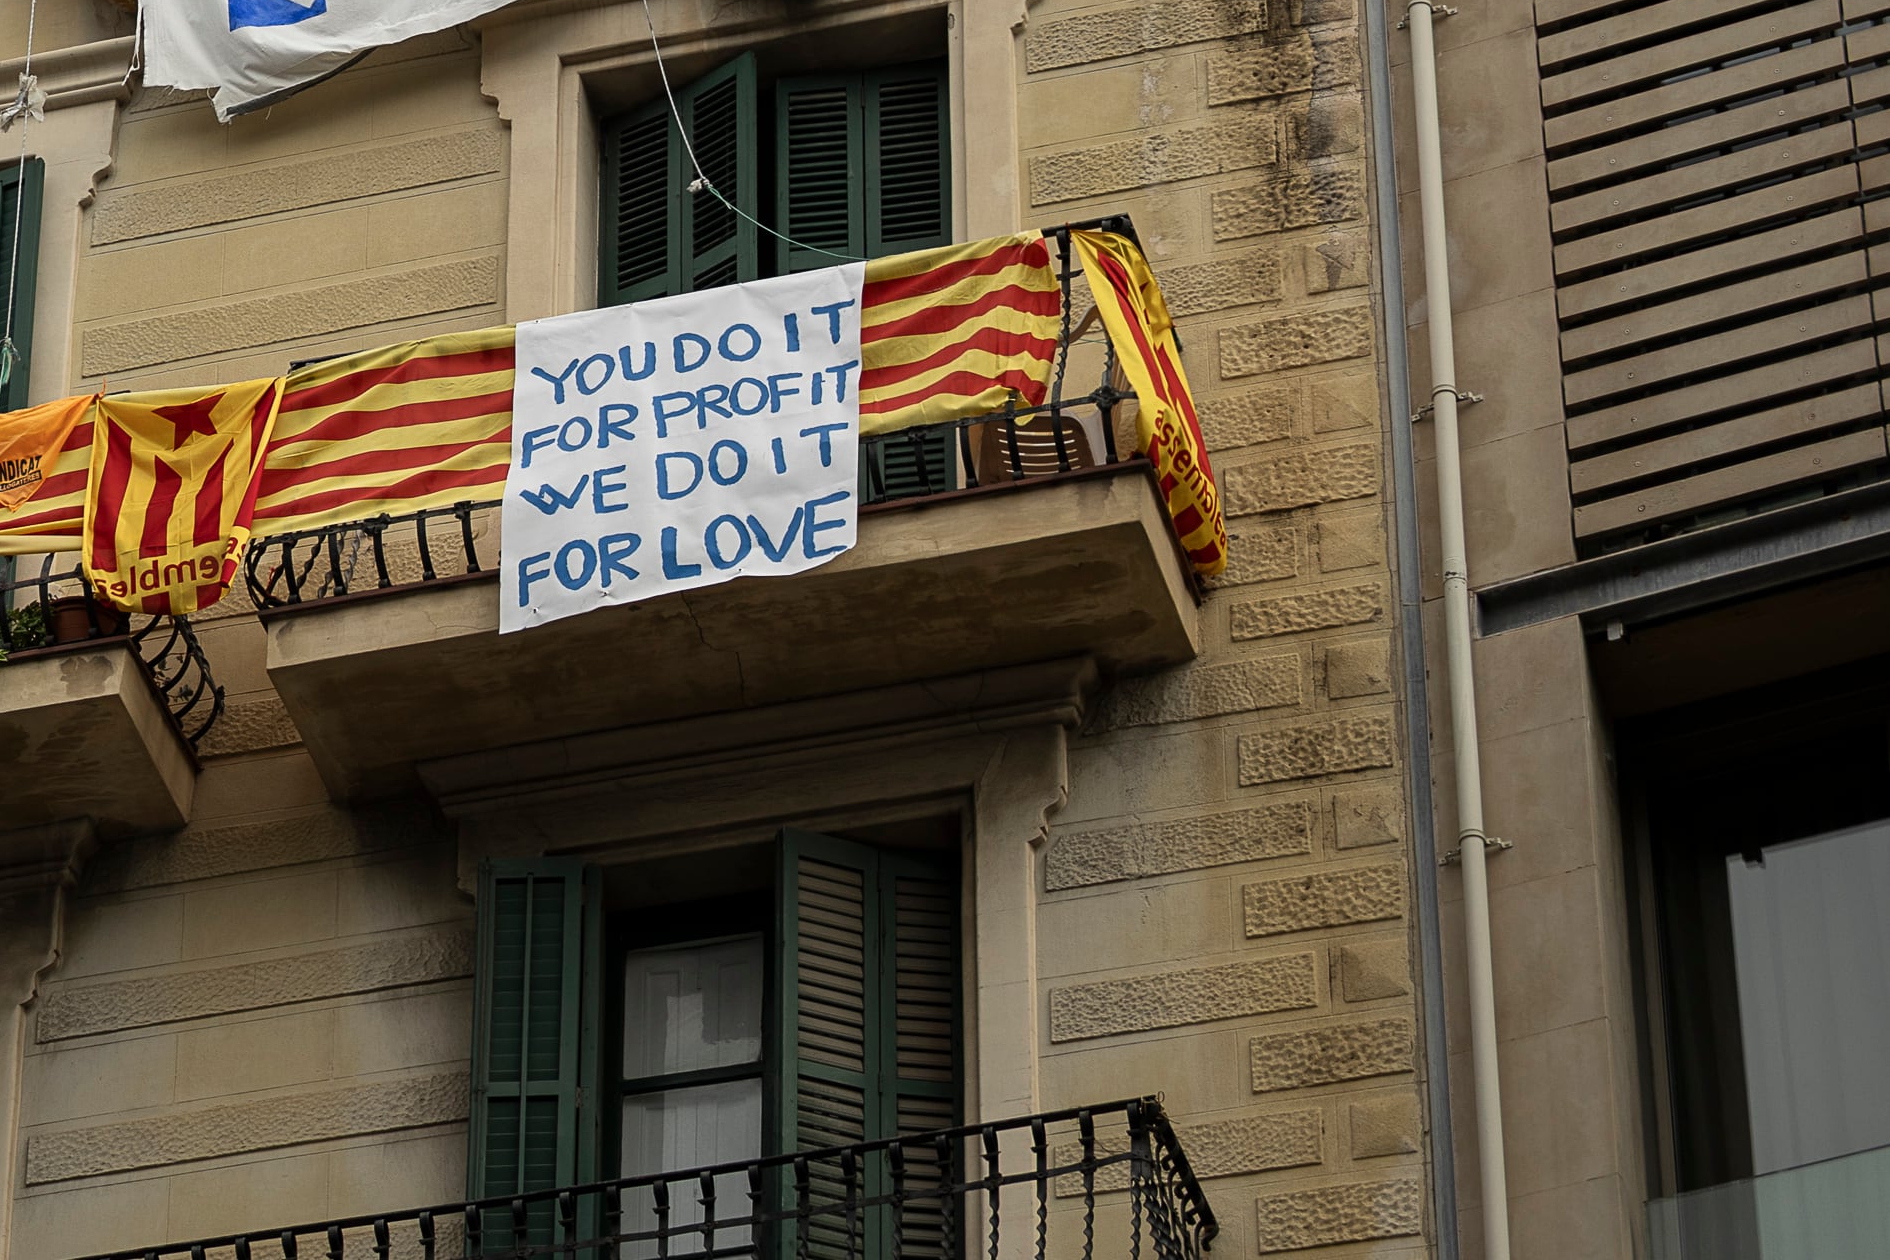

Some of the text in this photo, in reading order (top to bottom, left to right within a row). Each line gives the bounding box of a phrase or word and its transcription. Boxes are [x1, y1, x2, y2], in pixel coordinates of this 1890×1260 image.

[531, 299, 855, 404] YOU DO IT
[521, 360, 858, 468] FOR PROFIT
[520, 423, 848, 515] WE DO IT
[1155, 410, 1226, 549] assemblea
[519, 491, 850, 608] FOR LOVE
